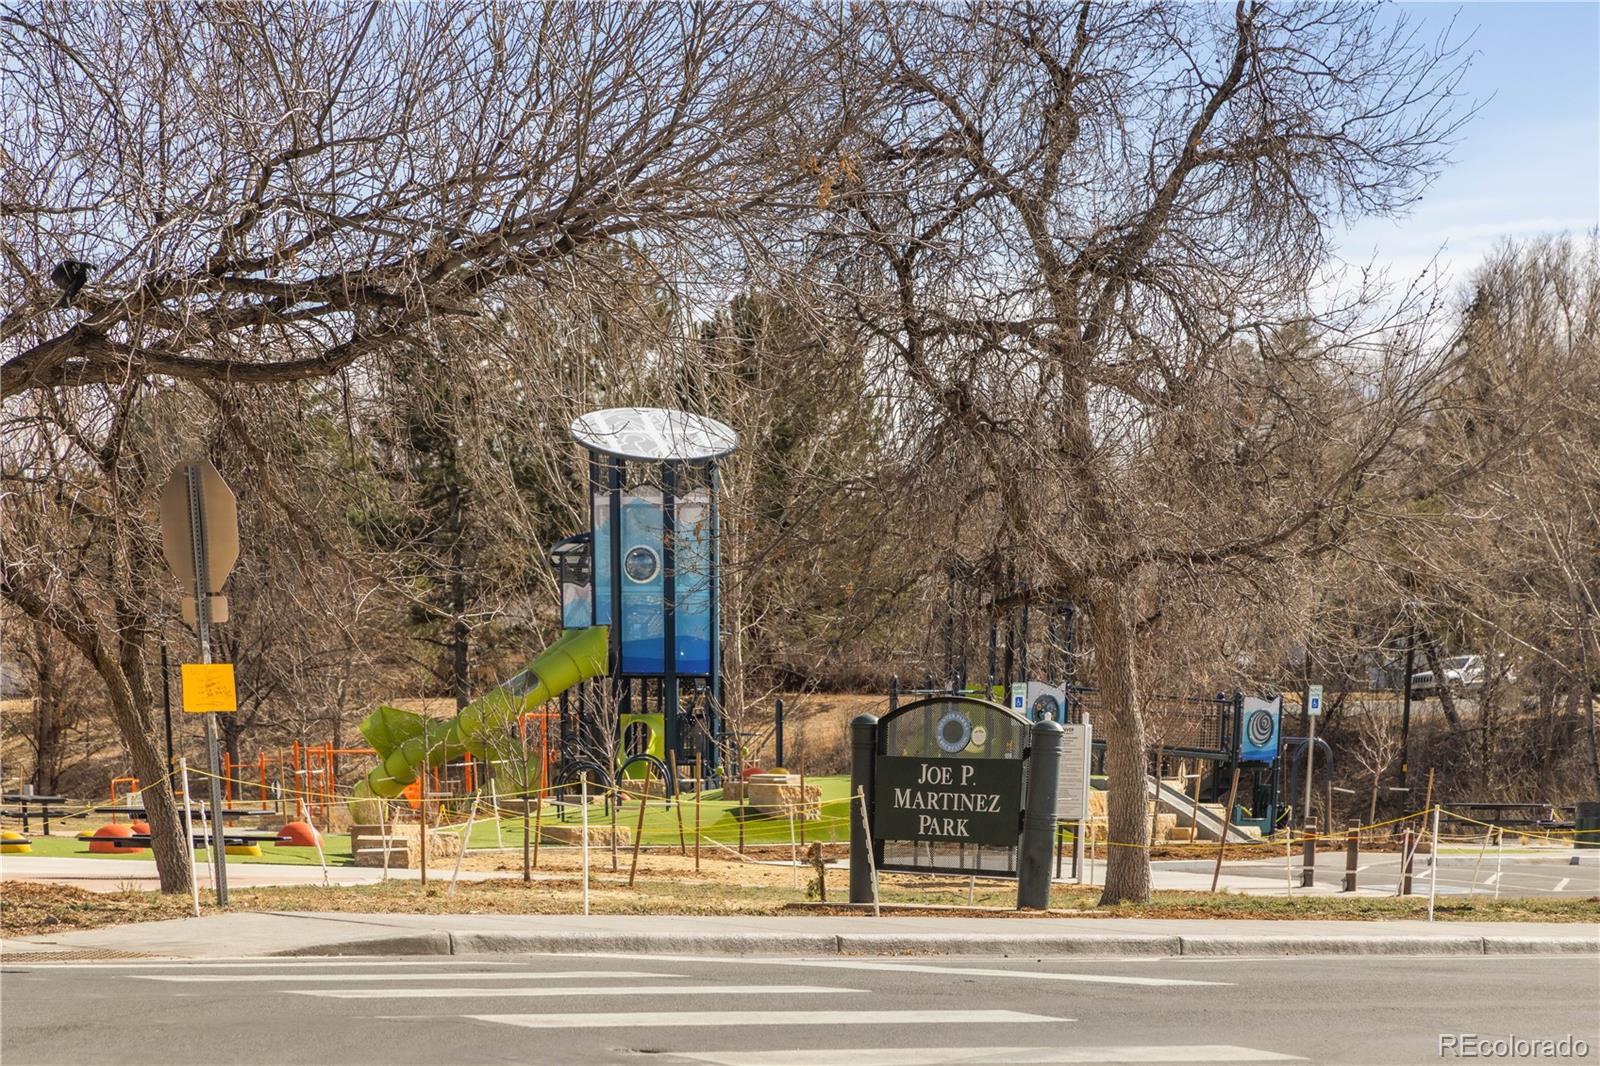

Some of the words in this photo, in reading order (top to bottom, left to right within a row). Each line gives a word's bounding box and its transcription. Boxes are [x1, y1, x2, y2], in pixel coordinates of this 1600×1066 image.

[918, 763, 953, 785] JOE
[961, 765, 976, 786] P.
[893, 788, 1001, 813] MARTINEZ
[918, 814, 970, 837] PARK
